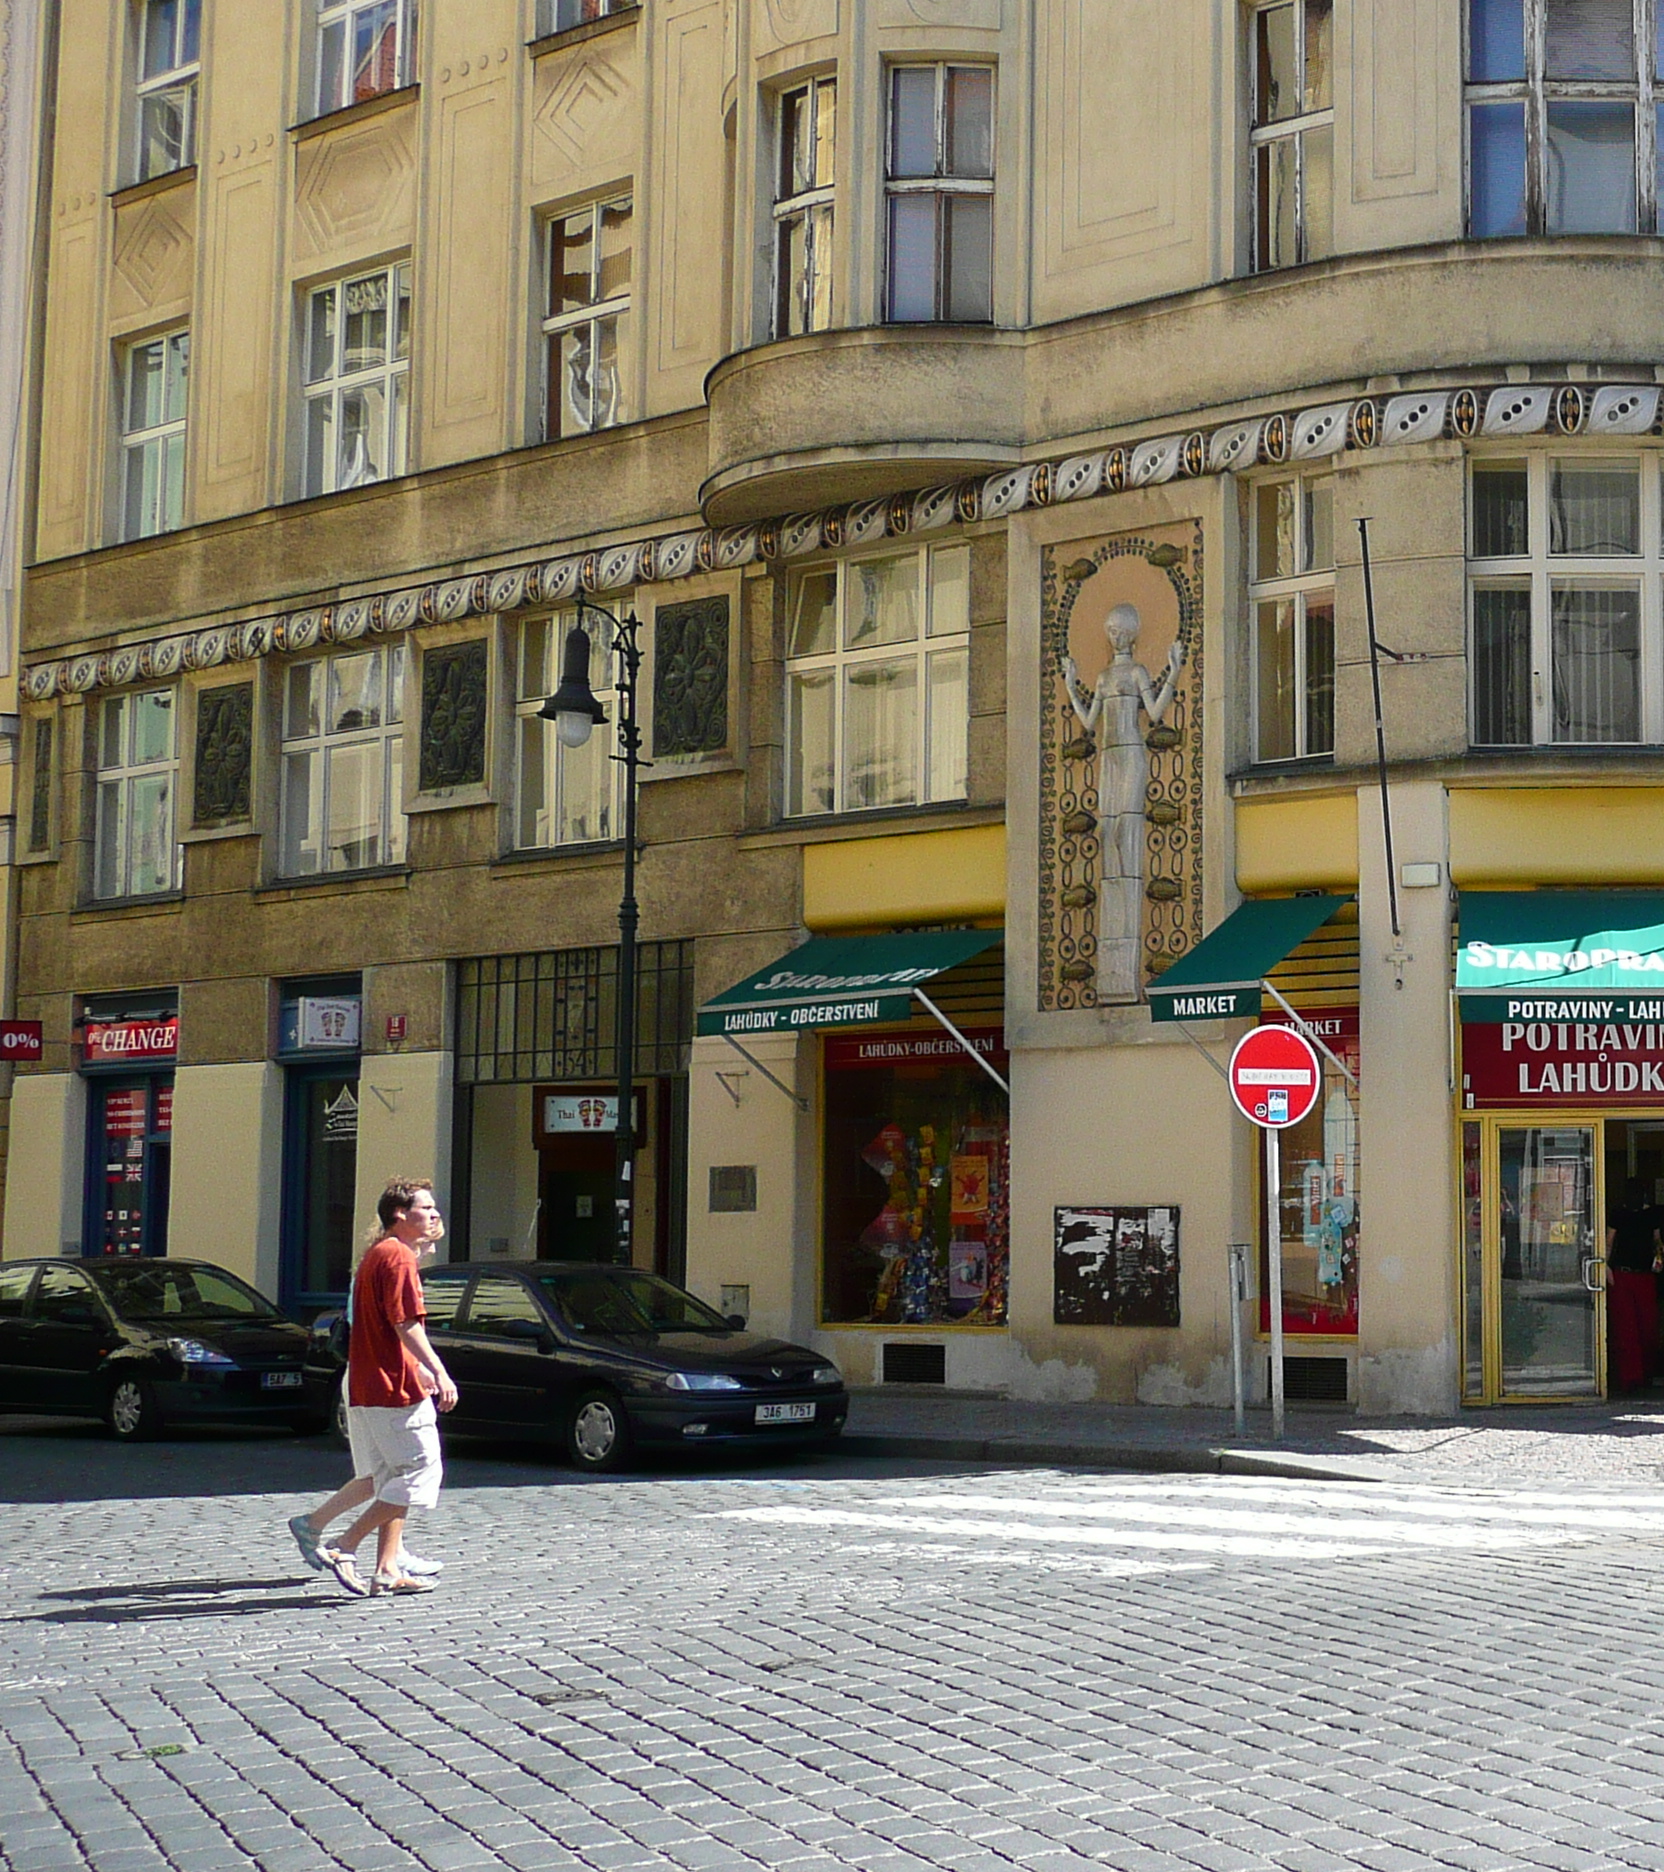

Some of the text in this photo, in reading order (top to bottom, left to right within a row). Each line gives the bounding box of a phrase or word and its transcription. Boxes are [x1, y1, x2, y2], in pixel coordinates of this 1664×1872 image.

[724, 1010, 778, 1031] LAHŮDKY
[790, 1000, 879, 1024] OBČERSTVENÍ
[1173, 995, 1237, 1016] MARKET
[1507, 1000, 1614, 1019] POTRAVINY
[3, 1032, 40, 1049] 0%
[102, 1026, 177, 1052] CHANGE
[557, 1109, 575, 1120] Thai
